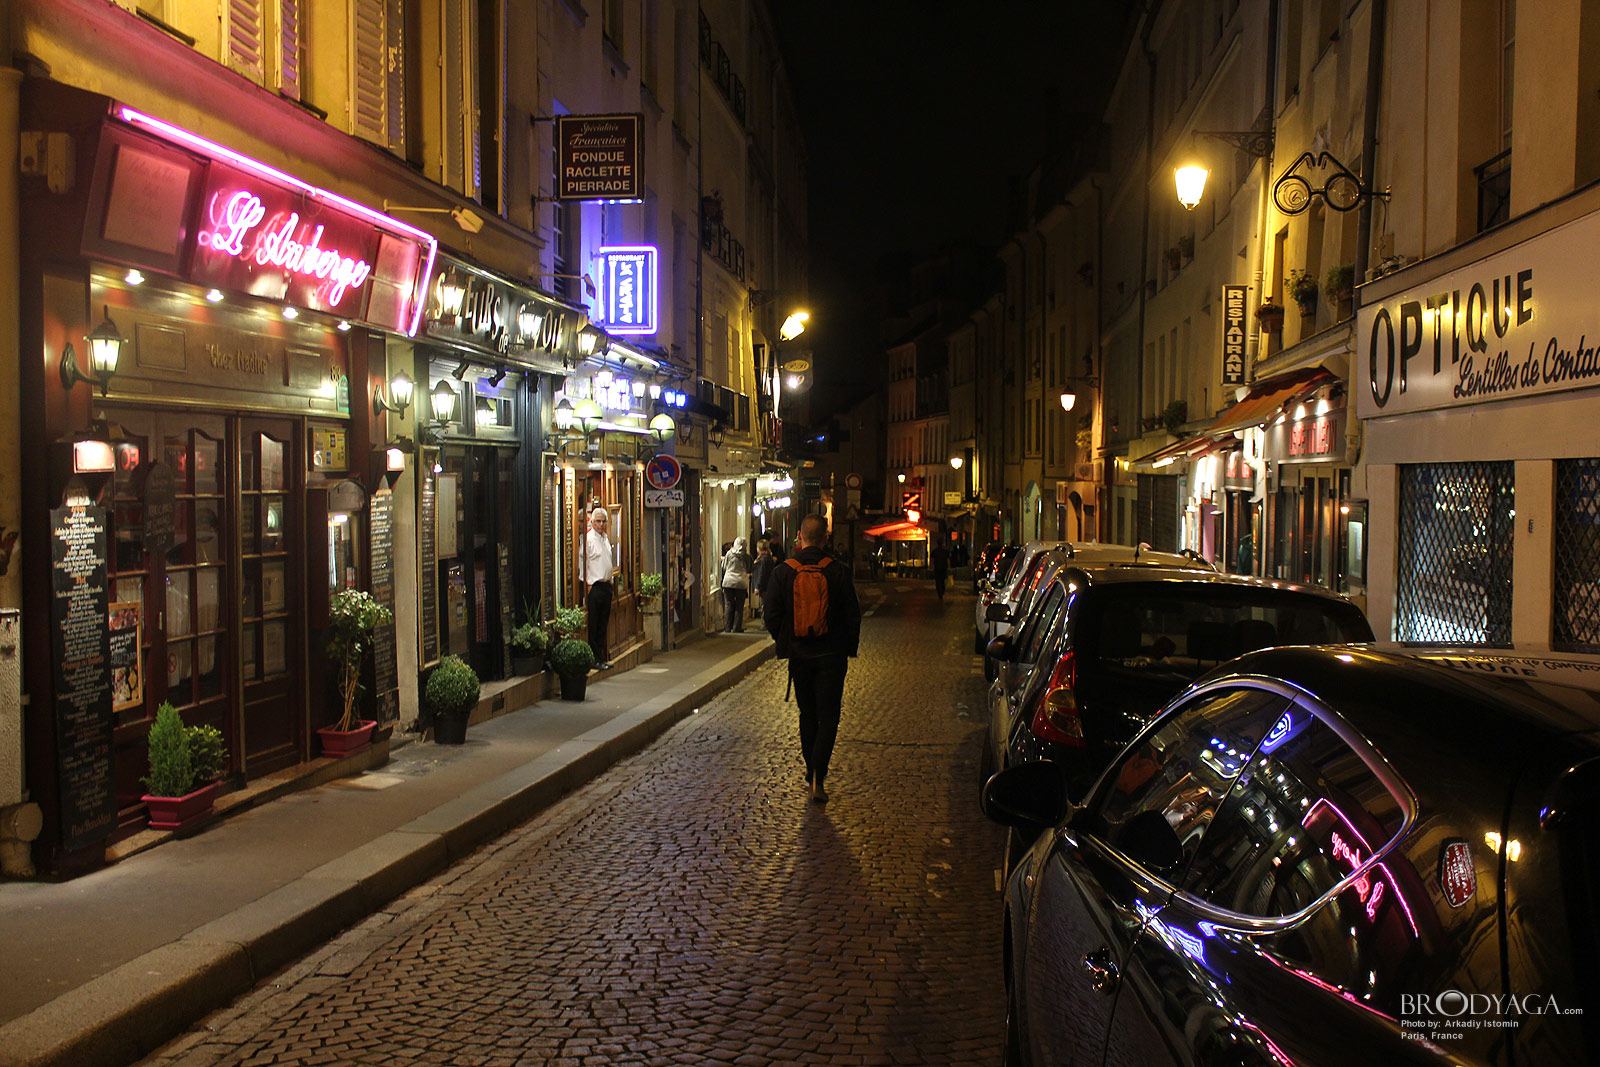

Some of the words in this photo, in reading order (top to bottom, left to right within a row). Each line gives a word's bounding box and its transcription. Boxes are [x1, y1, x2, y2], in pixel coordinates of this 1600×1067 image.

[569, 133, 627, 148] Françaises
[572, 151, 625, 163] FONDUE
[566, 165, 631, 178] RACLETTE
[567, 180, 630, 193] PIERRADE
[434, 272, 500, 341] SEURS
[1226, 289, 1244, 383] RESTAURANT
[1370, 269, 1533, 409] OPTIQUE
[1454, 350, 1518, 399] Lentilles
[1520, 341, 1540, 387] de
